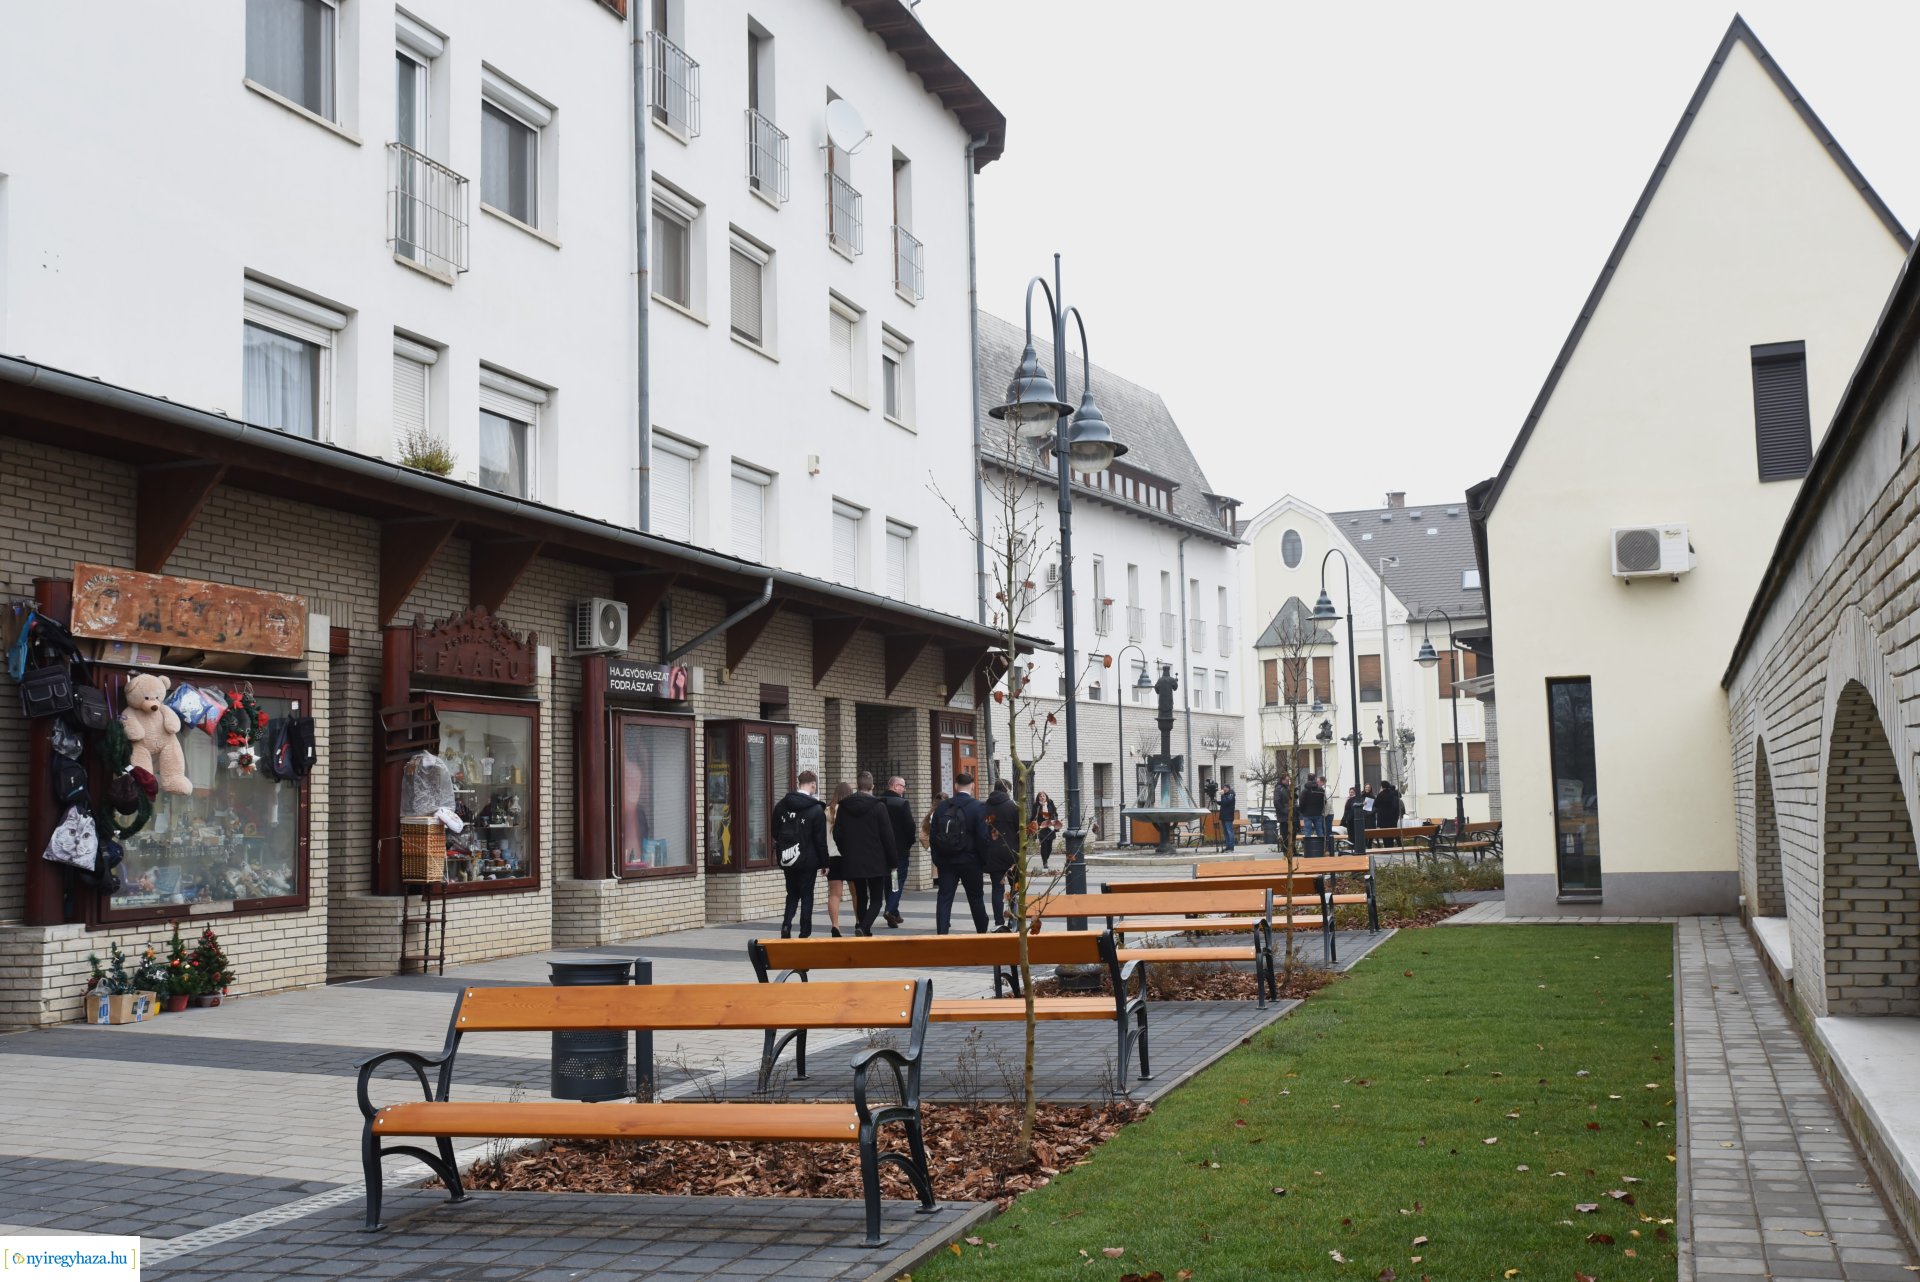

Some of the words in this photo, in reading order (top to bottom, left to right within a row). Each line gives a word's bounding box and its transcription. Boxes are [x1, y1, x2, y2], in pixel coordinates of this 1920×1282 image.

[435, 651, 519, 680] FAÁRU
[609, 666, 670, 682] HAJGYÓGYÁSZAT
[610, 679, 655, 693] FODRÁSZAT
[782, 842, 800, 862] NIKE
